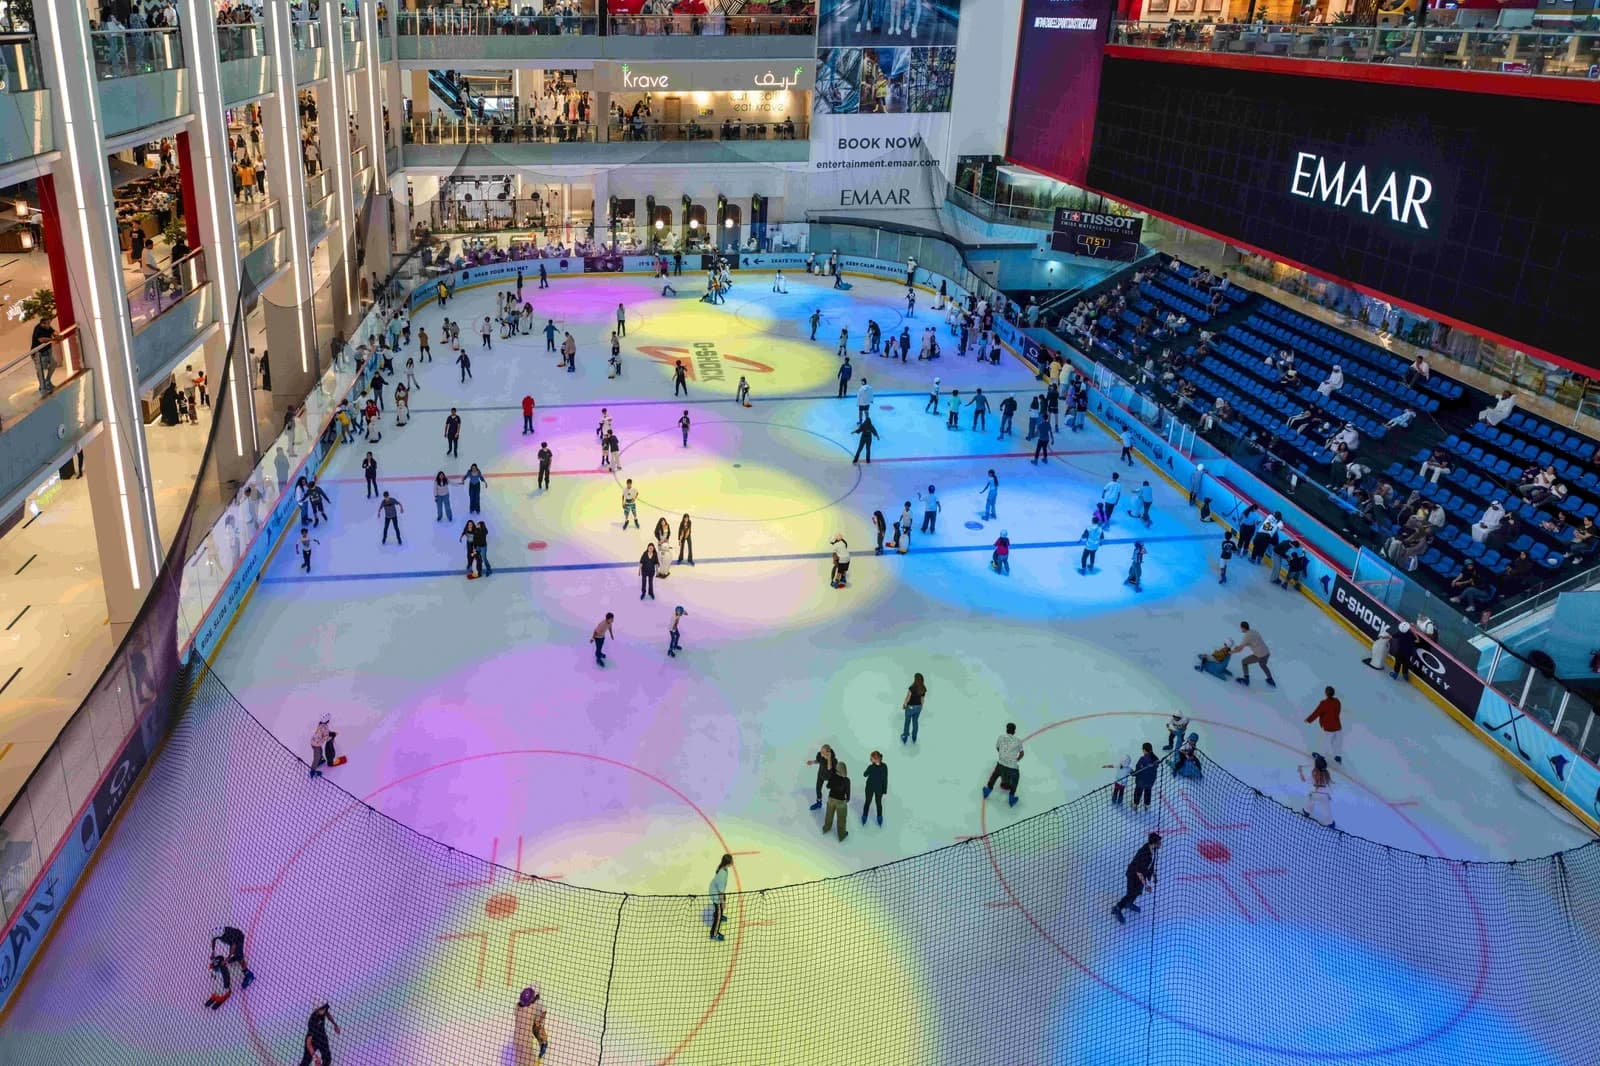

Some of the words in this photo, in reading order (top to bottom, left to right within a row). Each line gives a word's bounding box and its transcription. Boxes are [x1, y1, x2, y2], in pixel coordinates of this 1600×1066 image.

[623, 68, 669, 88] Krave
[838, 138, 881, 150] BOOK
[885, 137, 922, 149] NOW
[816, 159, 940, 169] entertainment.emaar.com
[840, 188, 911, 206] EMAAR
[1290, 151, 1432, 229] EMAAR
[1081, 212, 1135, 229] TISSOT
[693, 342, 726, 382] G-SHOCK
[1336, 587, 1391, 634] G-SHOCK
